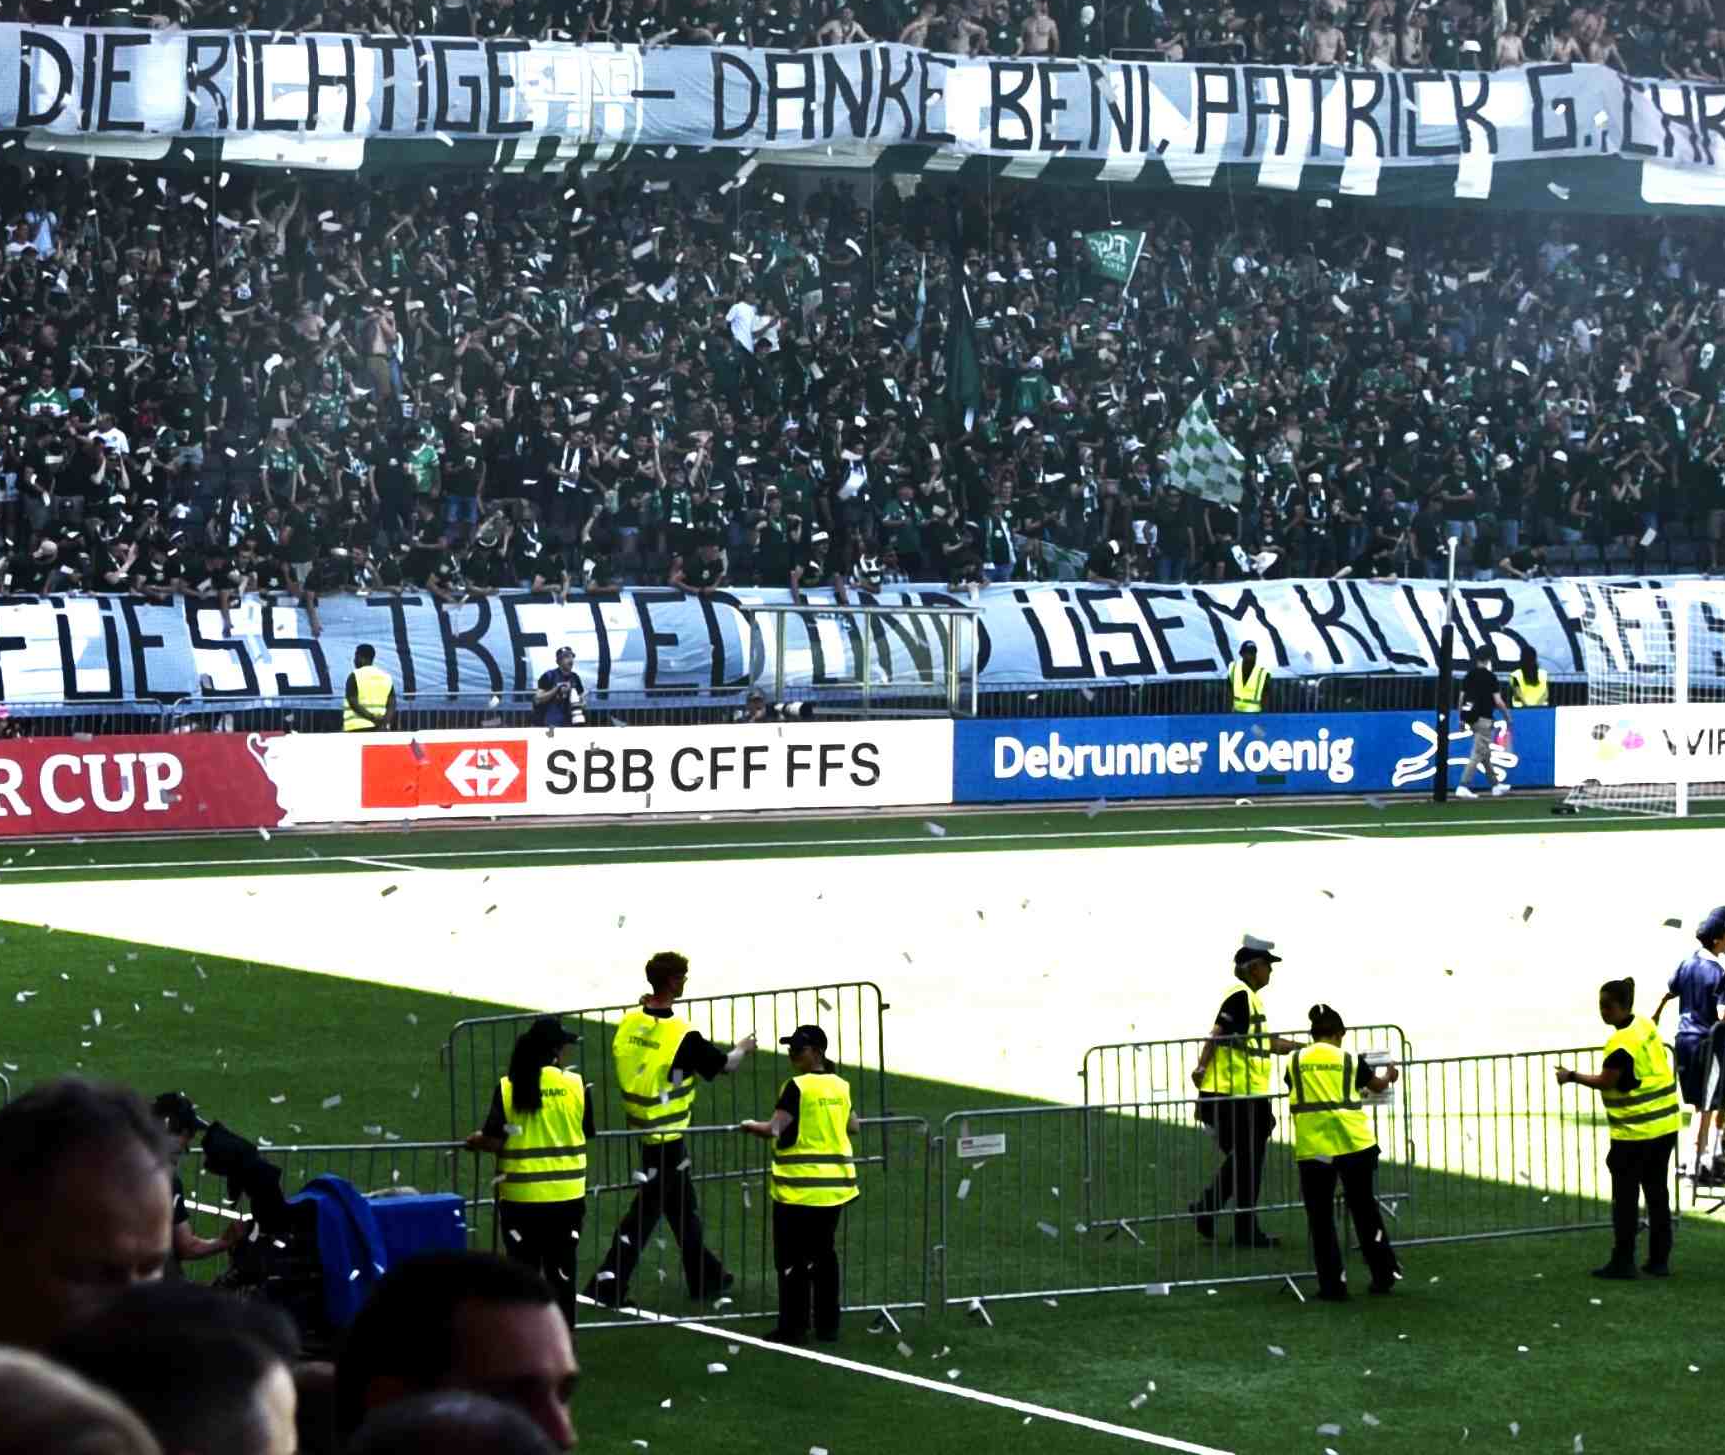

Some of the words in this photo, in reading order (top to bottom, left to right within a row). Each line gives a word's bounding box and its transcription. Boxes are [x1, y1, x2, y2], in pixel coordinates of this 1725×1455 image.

[18, 30, 152, 132] DIE
[182, 33, 534, 134] RICHTIGE
[712, 47, 958, 142] DANKE
[988, 62, 1170, 154] BENI,
[1195, 65, 1498, 158] PATRICK
[366, 590, 766, 702] TRETED
[793, 590, 993, 687] UND
[1013, 585, 1291, 681] ÜSEM
[39, 752, 184, 814] CUP
[545, 747, 655, 796] SBB
[670, 744, 770, 793] CFF
[786, 741, 882, 788] FFS
[994, 731, 1208, 780] Debrunner
[1219, 727, 1355, 783] Koenig
[541, 1088, 568, 1097] WARD
